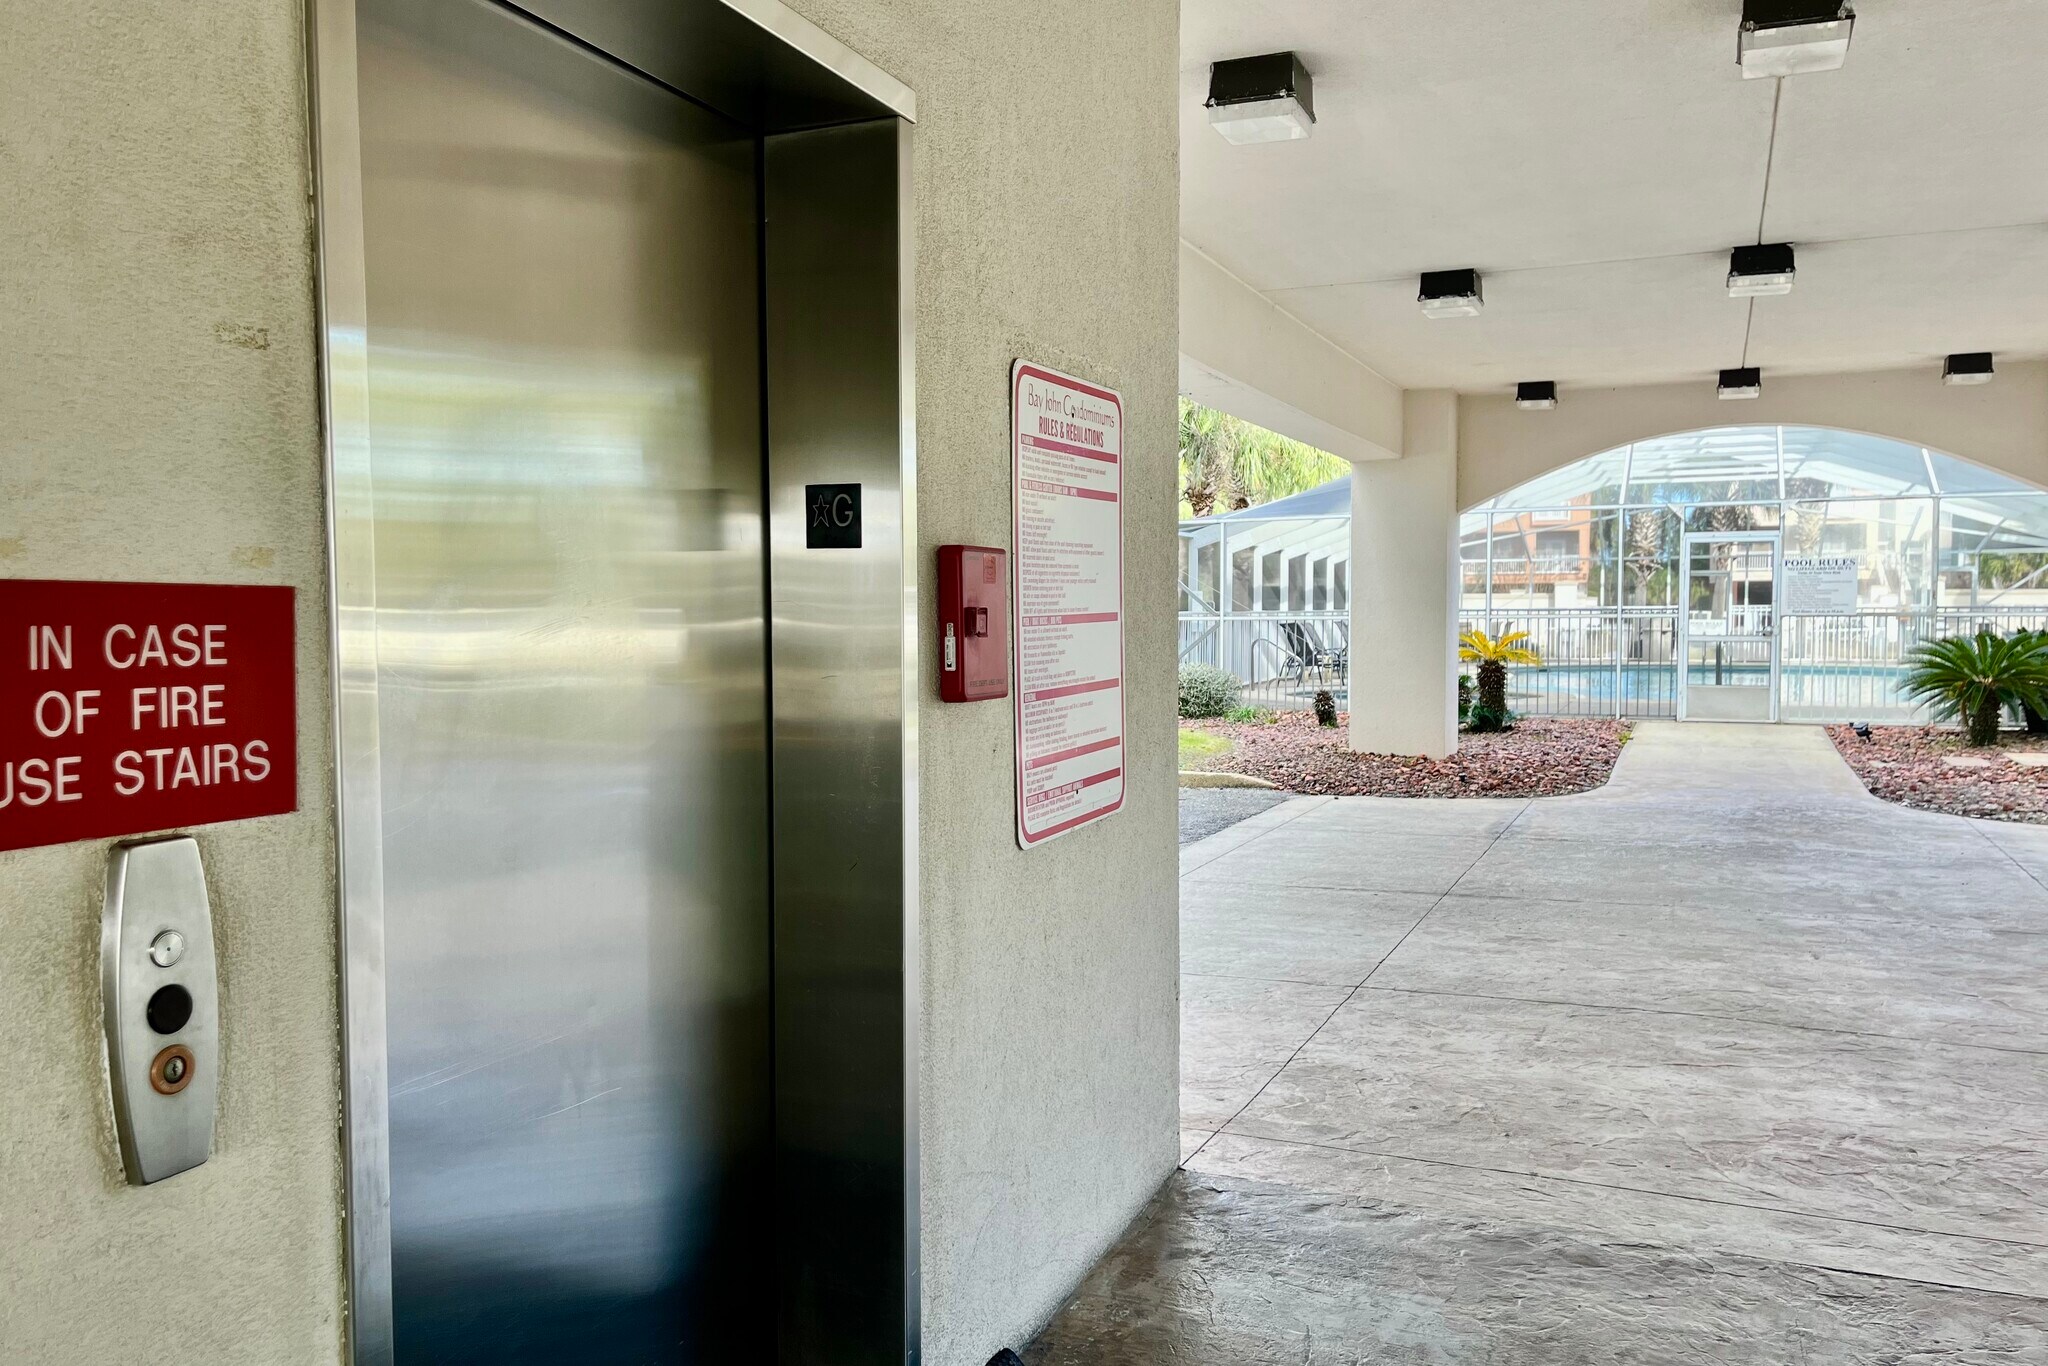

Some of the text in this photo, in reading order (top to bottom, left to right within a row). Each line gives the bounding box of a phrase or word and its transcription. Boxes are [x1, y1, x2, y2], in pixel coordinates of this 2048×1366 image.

[1028, 382, 1115, 428] Bay John Condominiums
[1038, 415, 1104, 448] RULES & REGULATIONS
[832, 493, 853, 527] G
[1784, 558, 1856, 567] POOL RULES
[28, 623, 229, 671] IN CASE
[34, 684, 227, 739] OF FIRE
[113, 739, 271, 796] STAIRS
